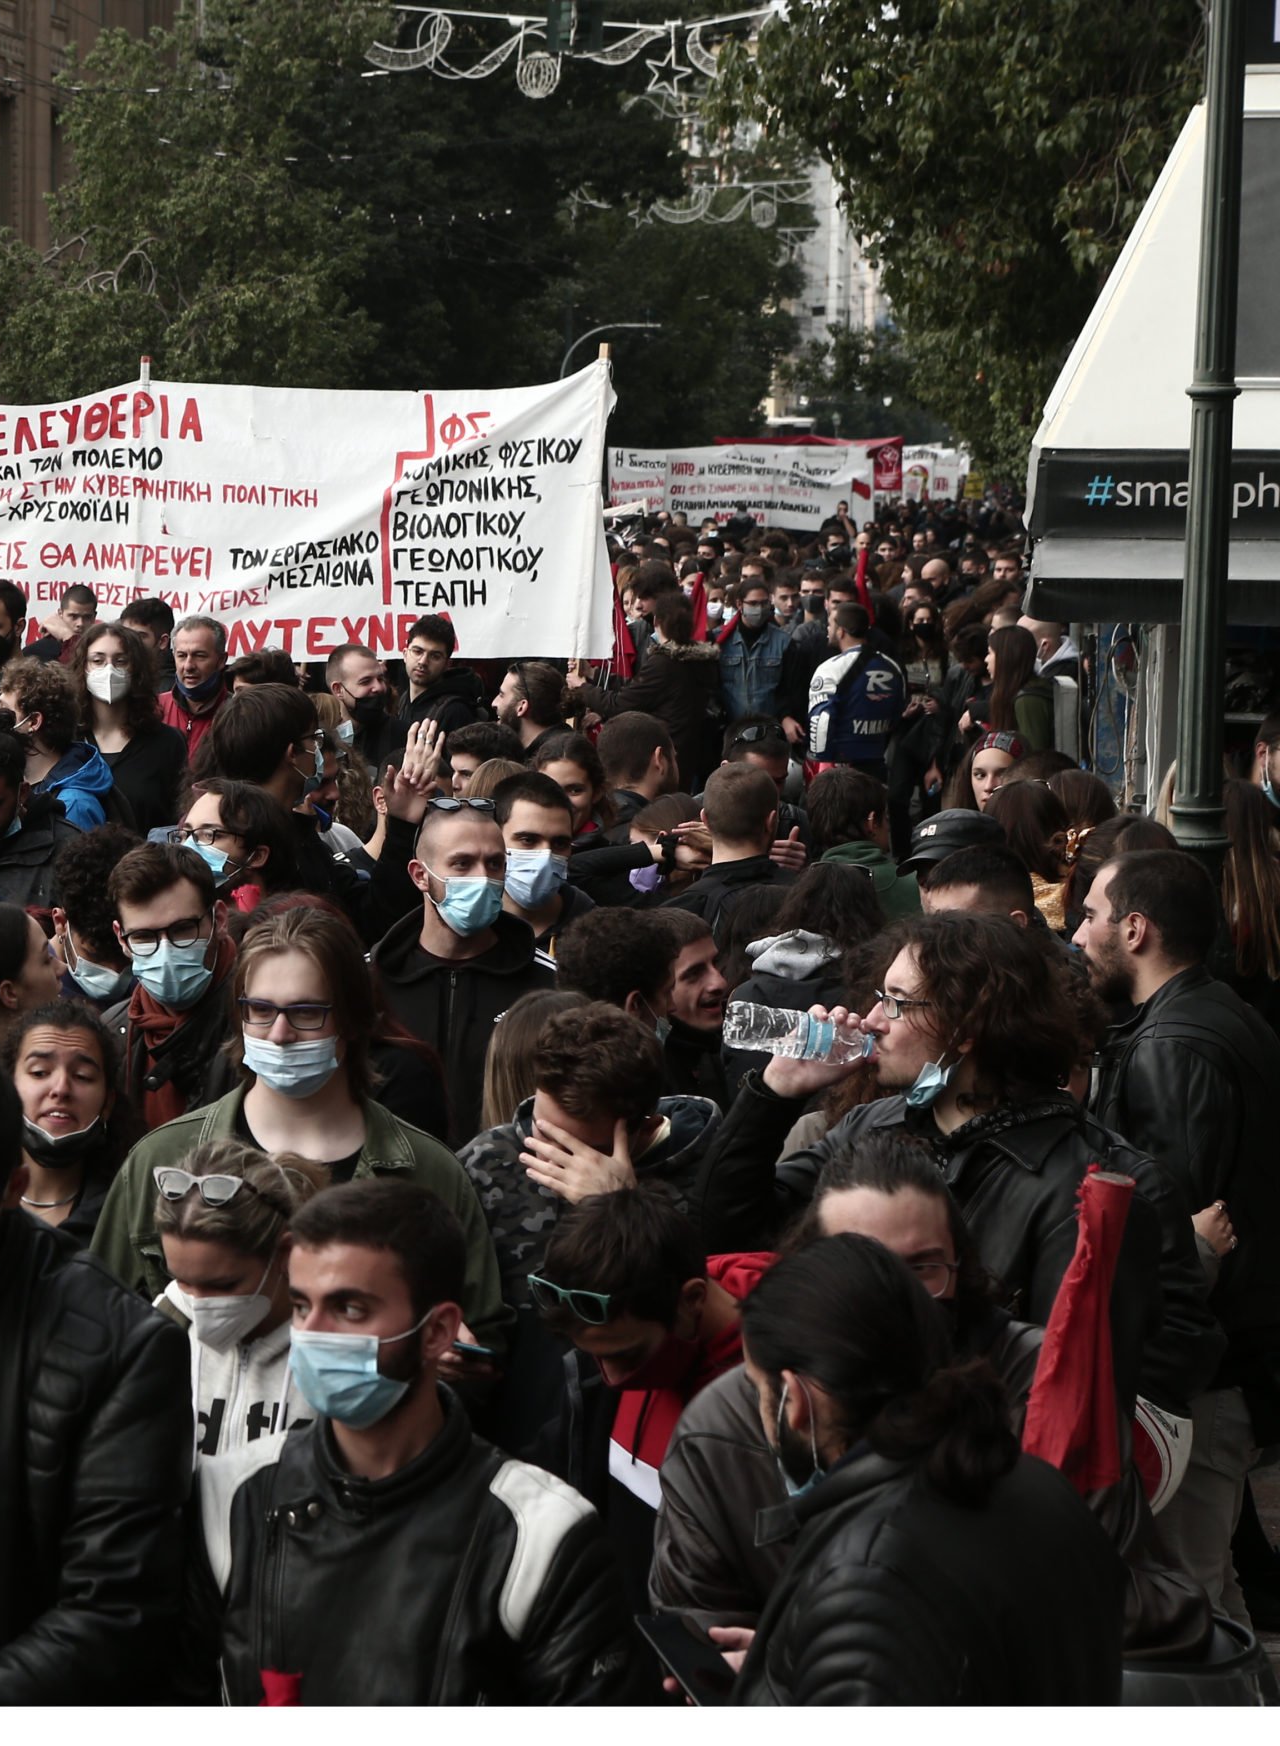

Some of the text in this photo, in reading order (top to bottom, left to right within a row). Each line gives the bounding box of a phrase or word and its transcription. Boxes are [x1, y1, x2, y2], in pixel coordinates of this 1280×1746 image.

[29, 452, 63, 474] ΤΟΝ
[72, 446, 163, 471] ΠΟΛΕΜΟ
[498, 437, 583, 469] ΦΥΣΙΚΟΥ
[20, 475, 77, 501] ΣΤΗΝ
[82, 473, 212, 504] ΚΥΒΕΡΝΗΤΙΚΗ
[223, 484, 319, 508] ΠΟΛΙΤΙΚΗ
[40, 542, 77, 569] ΘΑ
[83, 542, 213, 581] ΑΝΑΤΡΕΨΕΙ
[229, 547, 269, 571] ΤΟΝ
[270, 530, 379, 568] ΕΡΓΑΣΙΑΚΟ
[268, 558, 374, 590] ΜΕΣΑΙΩΝΑ
[159, 590, 190, 614] ΚΑΙ
[394, 578, 487, 608] ΤΕΑΠΗ
